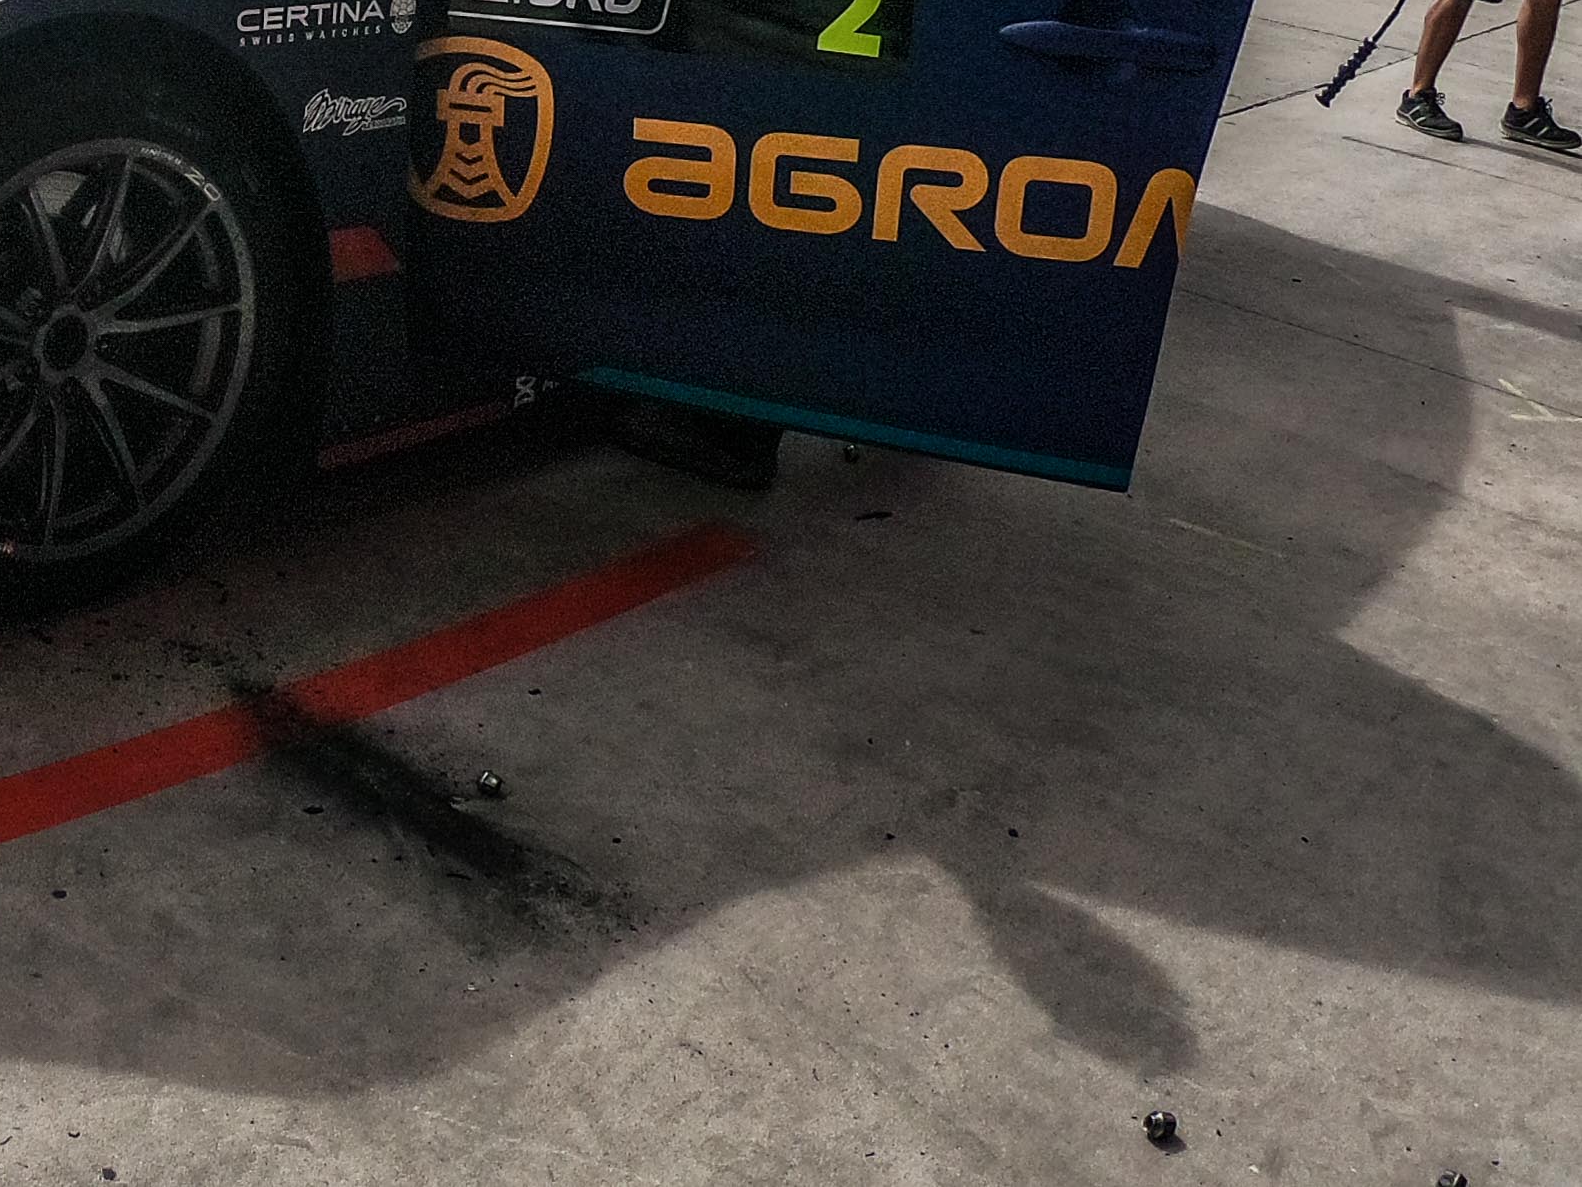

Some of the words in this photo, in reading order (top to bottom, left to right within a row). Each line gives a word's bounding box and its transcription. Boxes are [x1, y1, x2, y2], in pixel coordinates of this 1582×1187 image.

[236, 0, 385, 32] CERTINA
[239, 33, 295, 47] SWISS
[305, 24, 381, 41] WATCHES
